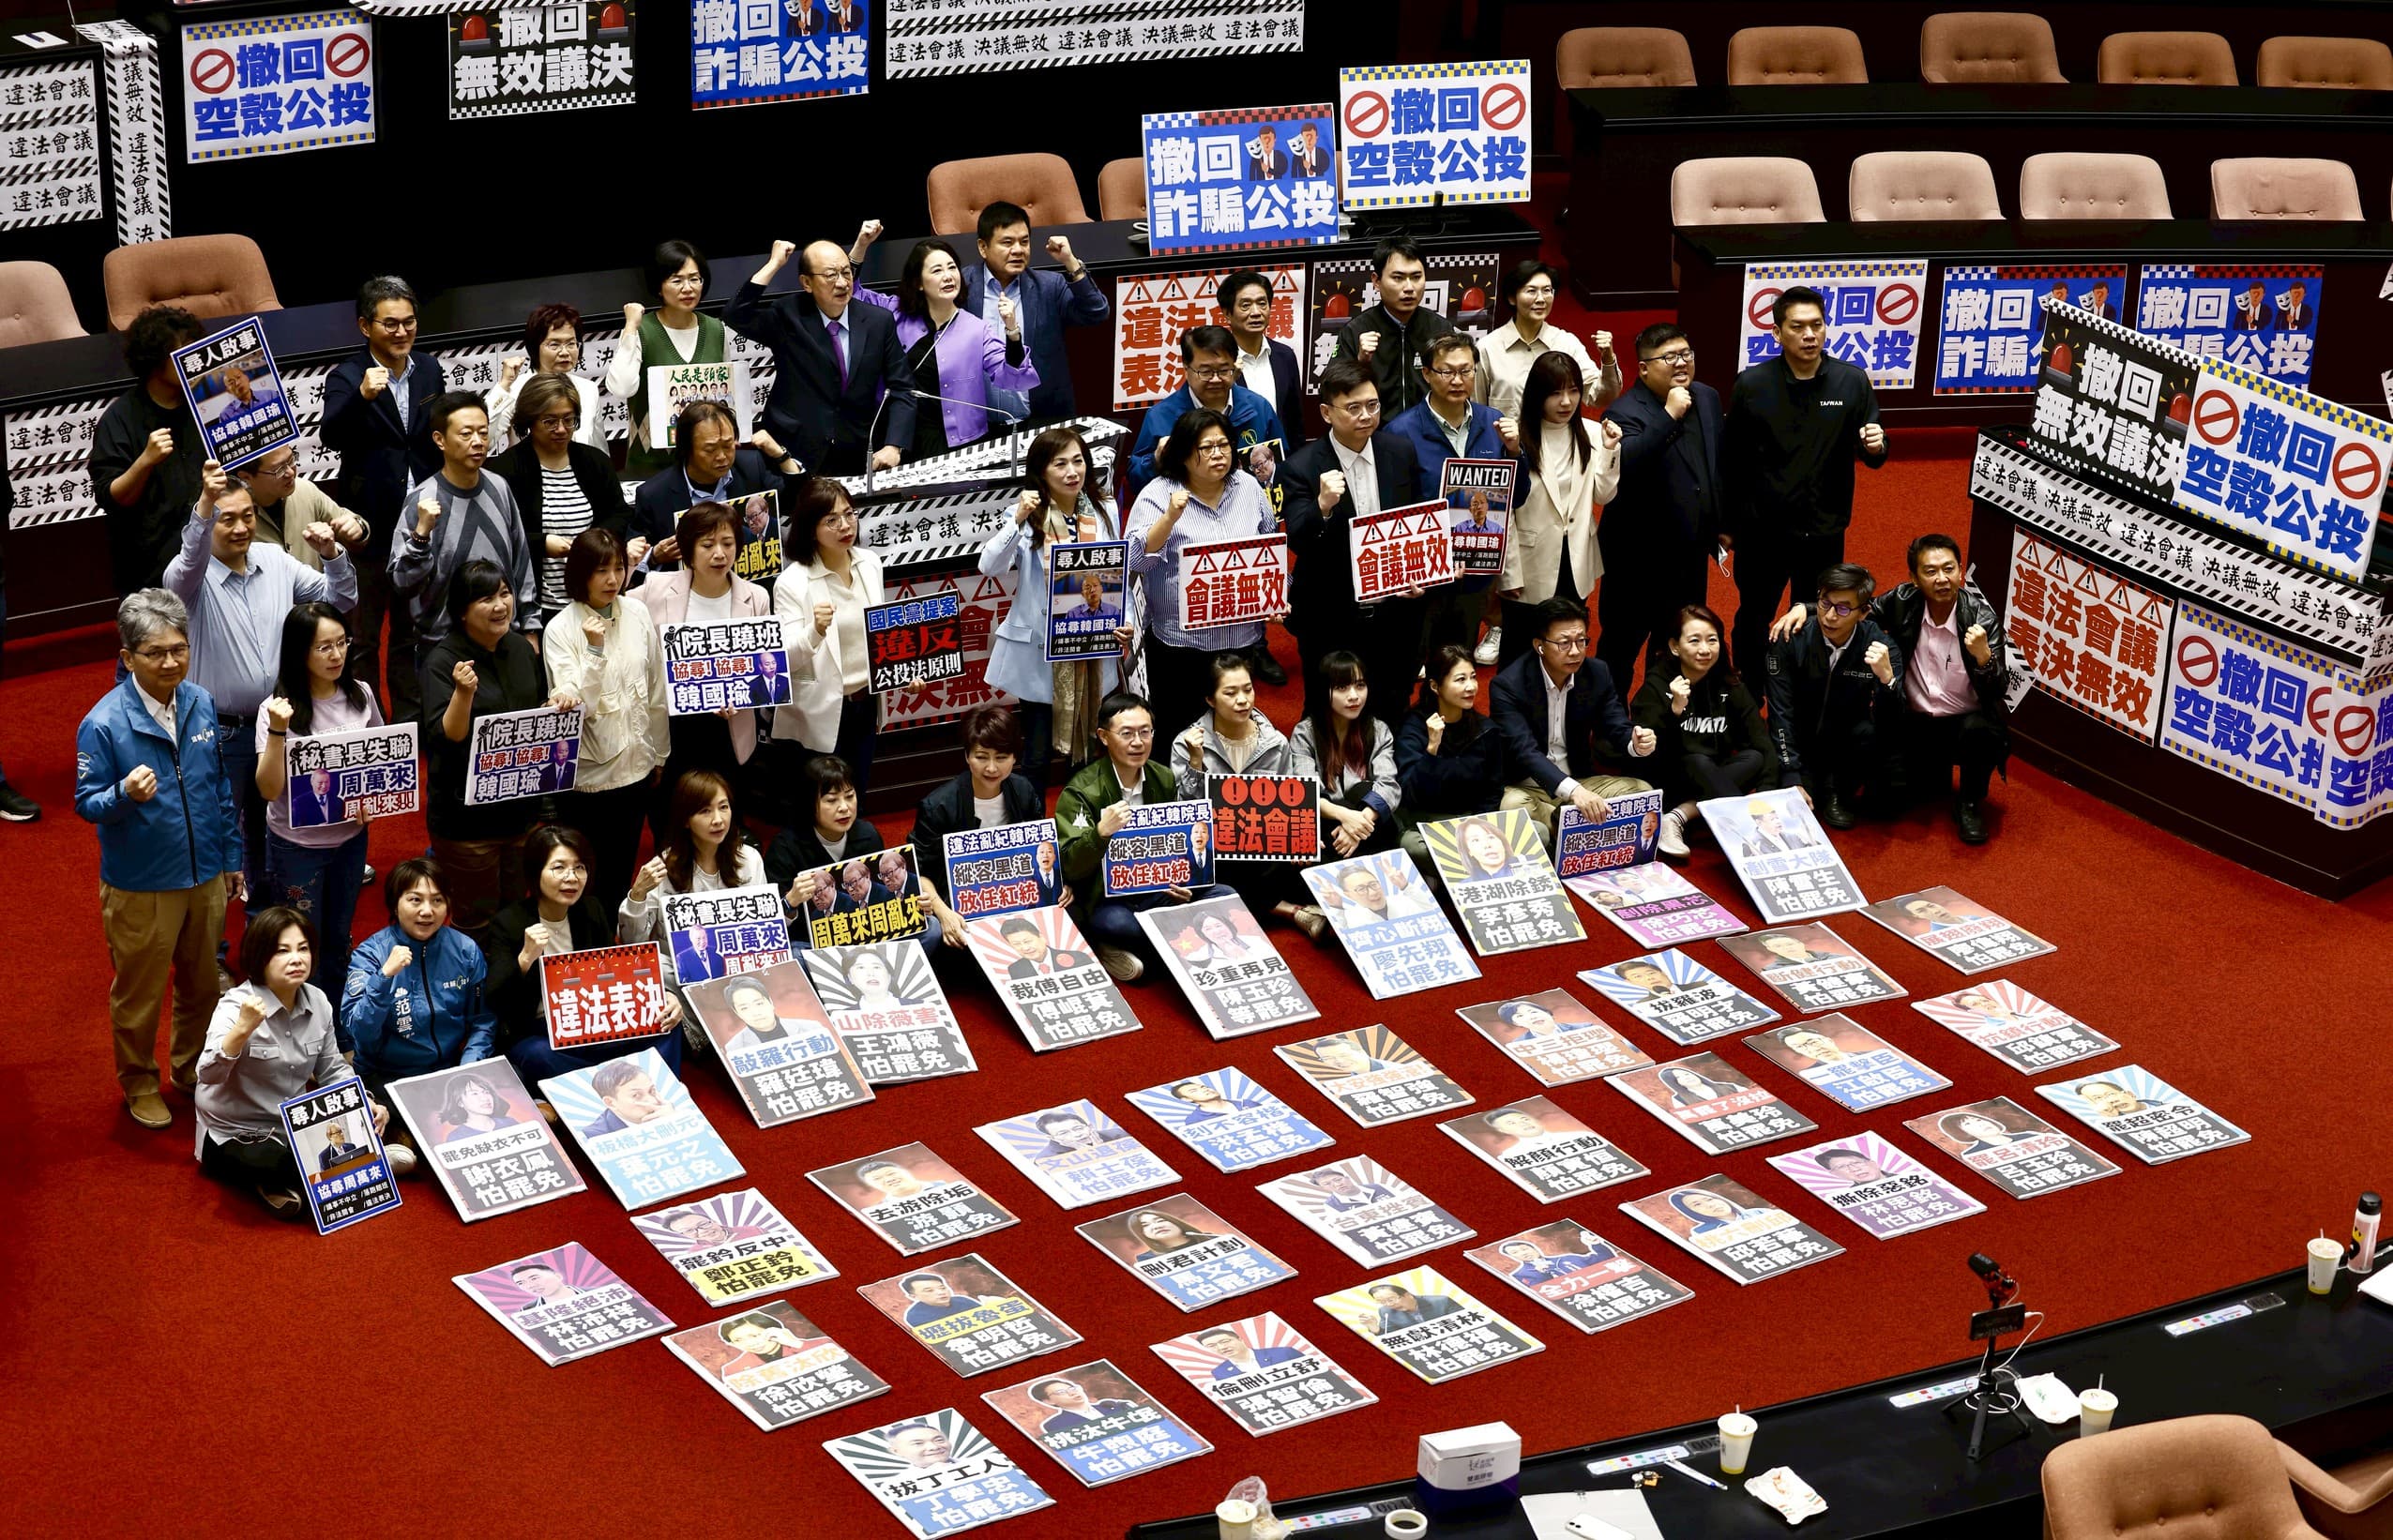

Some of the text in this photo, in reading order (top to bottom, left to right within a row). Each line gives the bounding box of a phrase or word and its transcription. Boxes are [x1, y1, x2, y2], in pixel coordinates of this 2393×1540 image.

[499, 2, 587, 48] 撤回
[693, 0, 780, 46] 撤回
[889, 18, 1299, 63] 違法會議 決議無效 違法會議 決議無效 違法會議
[236, 38, 325, 89] 撤回
[454, 43, 634, 100] 無效議決
[694, 35, 868, 92] 詐騙公投
[5, 75, 91, 105] 違法會議
[194, 82, 371, 142] 空殼公投
[1390, 86, 1479, 135] 撤回
[8, 129, 95, 159] 違法會議
[121, 41, 154, 216] 決議無效 違法會議
[1150, 133, 1243, 187] 撤回
[1347, 135, 1527, 189] 空殼公投
[13, 183, 98, 212] 違法會議
[1152, 180, 1337, 238] 詐騙公投
[1945, 288, 2034, 333] 撤回
[2142, 284, 2231, 329] 撤回
[183, 329, 257, 373] 尋人啟事
[670, 366, 729, 384] 人民是頭家
[2079, 342, 2162, 424] 撤回
[211, 402, 281, 444] 協尋韓國瑜
[2032, 383, 2187, 491] 無效議決
[2236, 401, 2336, 487] 撤回
[1449, 467, 1509, 486] WANTED
[2178, 444, 2370, 563] 空殼公投
[869, 515, 962, 549] 違法會議
[1976, 455, 2375, 641] 違法會議 決議無效 違法會議 決議無效 違法會議
[1057, 549, 1123, 568] 尋人啟事
[1357, 534, 1449, 594] 會議無效
[1186, 567, 1286, 623] 會議無效
[868, 595, 959, 632] 國民黨提案
[1054, 618, 1116, 635] 協尋韓國瑜
[2011, 565, 2159, 677] 違法會議
[681, 622, 782, 656] 院長蹺班
[872, 620, 960, 665] 違反
[875, 652, 962, 689] 公投法原則
[2008, 616, 2153, 729] 表決無效
[2218, 647, 2309, 727] 撤回
[674, 680, 751, 712] 韓國瑜
[490, 711, 580, 748] 院長蹺班
[1681, 713, 1727, 732] iwan
[298, 733, 412, 771] 秘書長失聯
[339, 763, 416, 798] 周萬來
[476, 769, 541, 802] 韓國瑜
[948, 823, 1054, 854] 違法亂紀韓院長
[1109, 833, 1187, 861] 縱容黑道
[1214, 807, 1316, 854] 違法會議
[1565, 823, 1637, 853] 縱容黑道
[954, 853, 1034, 885] 縱容黑道
[1111, 860, 1190, 888] 放任紅統
[1561, 845, 1635, 876] 放任紅統
[957, 880, 1039, 914] 放任紅統
[1764, 870, 1841, 896] 陳雪生
[1776, 887, 1851, 913] 怕罷免
[674, 895, 778, 928] 秘書長失聯
[811, 895, 925, 949] 周萬來周亂來
[1641, 906, 1721, 931] 徐巧芯
[1651, 917, 1733, 941] 怕罷免
[715, 923, 786, 954] 周萬來
[1485, 919, 1567, 946] 怕罷免
[1194, 957, 1288, 987] 珍重再見
[1371, 939, 1452, 970] 廖先翔
[1011, 969, 1109, 1002] 裁傅自由
[1383, 959, 1463, 990] 怕罷免
[550, 976, 666, 1039] 違法表決
[1215, 978, 1293, 1007] 陳玉珍
[1649, 988, 1720, 1014] 拔羅波
[1804, 984, 1886, 1006] 怕罷免
[395, 998, 413, 1033] 范雲
[1043, 1010, 1127, 1042] 怕罷免
[1227, 995, 1308, 1026] 等罷免
[1661, 1000, 1743, 1027] 羅明才
[1679, 1012, 1760, 1038] 怕罷免
[731, 1034, 836, 1074] 敲羅行動
[856, 1031, 942, 1056] 王鴻薇
[752, 1057, 842, 1096] 羅廷瑋
[862, 1051, 950, 1076] 怕罷免
[1551, 1053, 1637, 1078] 怕罷免
[290, 1087, 360, 1125] 尋人啟事
[766, 1080, 855, 1117] 怕罷免
[1365, 1092, 1454, 1119] 怕罷免
[1853, 1079, 1932, 1104] 怕罷免
[442, 1127, 543, 1163] 罷免缺衣不可
[1222, 1133, 1311, 1165] 怕罷免
[1716, 1118, 1801, 1145] 怕罷免
[2147, 1128, 2230, 1156] 怕罷免
[618, 1139, 709, 1178] 葉元之
[1067, 1153, 1154, 1184] 賴士葆
[1504, 1135, 1604, 1169] 解顏行動
[1995, 1151, 2078, 1179] 呂玉玲
[317, 1166, 383, 1200] 協尋周萬來
[476, 1168, 566, 1207] 怕罷免
[632, 1160, 723, 1198] 怕罷免
[1080, 1167, 1167, 1195] 怕罷免
[1548, 1161, 1635, 1192] 怕罷免
[2013, 1162, 2098, 1191] 怕罷免
[870, 1184, 977, 1222] 去游除垢
[1859, 1188, 1943, 1218] 林思銘
[1877, 1200, 1960, 1230] 怕罷免
[910, 1212, 1002, 1247] 怕罷免
[1374, 1222, 1461, 1256] 怕罷免
[1140, 1236, 1248, 1277] 刪君計劃
[1170, 1251, 1259, 1290] 馬文君
[1741, 1241, 1829, 1274] 怕罷免
[716, 1264, 810, 1295] 怕罷免
[1186, 1265, 1277, 1302] 怕罷免
[518, 1285, 634, 1326] 基隆絕沛
[544, 1303, 638, 1338] 林沛祥
[1583, 1288, 1673, 1323] 怕罷免
[557, 1317, 654, 1351] 怕罷免
[945, 1316, 1038, 1356] 魯明哲
[962, 1330, 1057, 1369] 怕罷免
[1407, 1326, 1501, 1362] 林德福
[1426, 1340, 1520, 1375] 怕罷免
[753, 1364, 855, 1405] 徐欣瑩
[1211, 1357, 1321, 1397] 倫刪立舒
[770, 1378, 870, 1418] 怕罷免
[1234, 1376, 1335, 1414] 張智倫
[1253, 1389, 1352, 1428] 怕罷免
[1044, 1406, 1162, 1450] 桃汰牛氓
[1071, 1425, 1173, 1462] 牛煦庭
[1087, 1440, 1188, 1477] 怕罷免
[888, 1458, 1010, 1499] 拔丁工人
[913, 1475, 1019, 1513] 丁學忠
[930, 1489, 1036, 1529] 怕罷免
